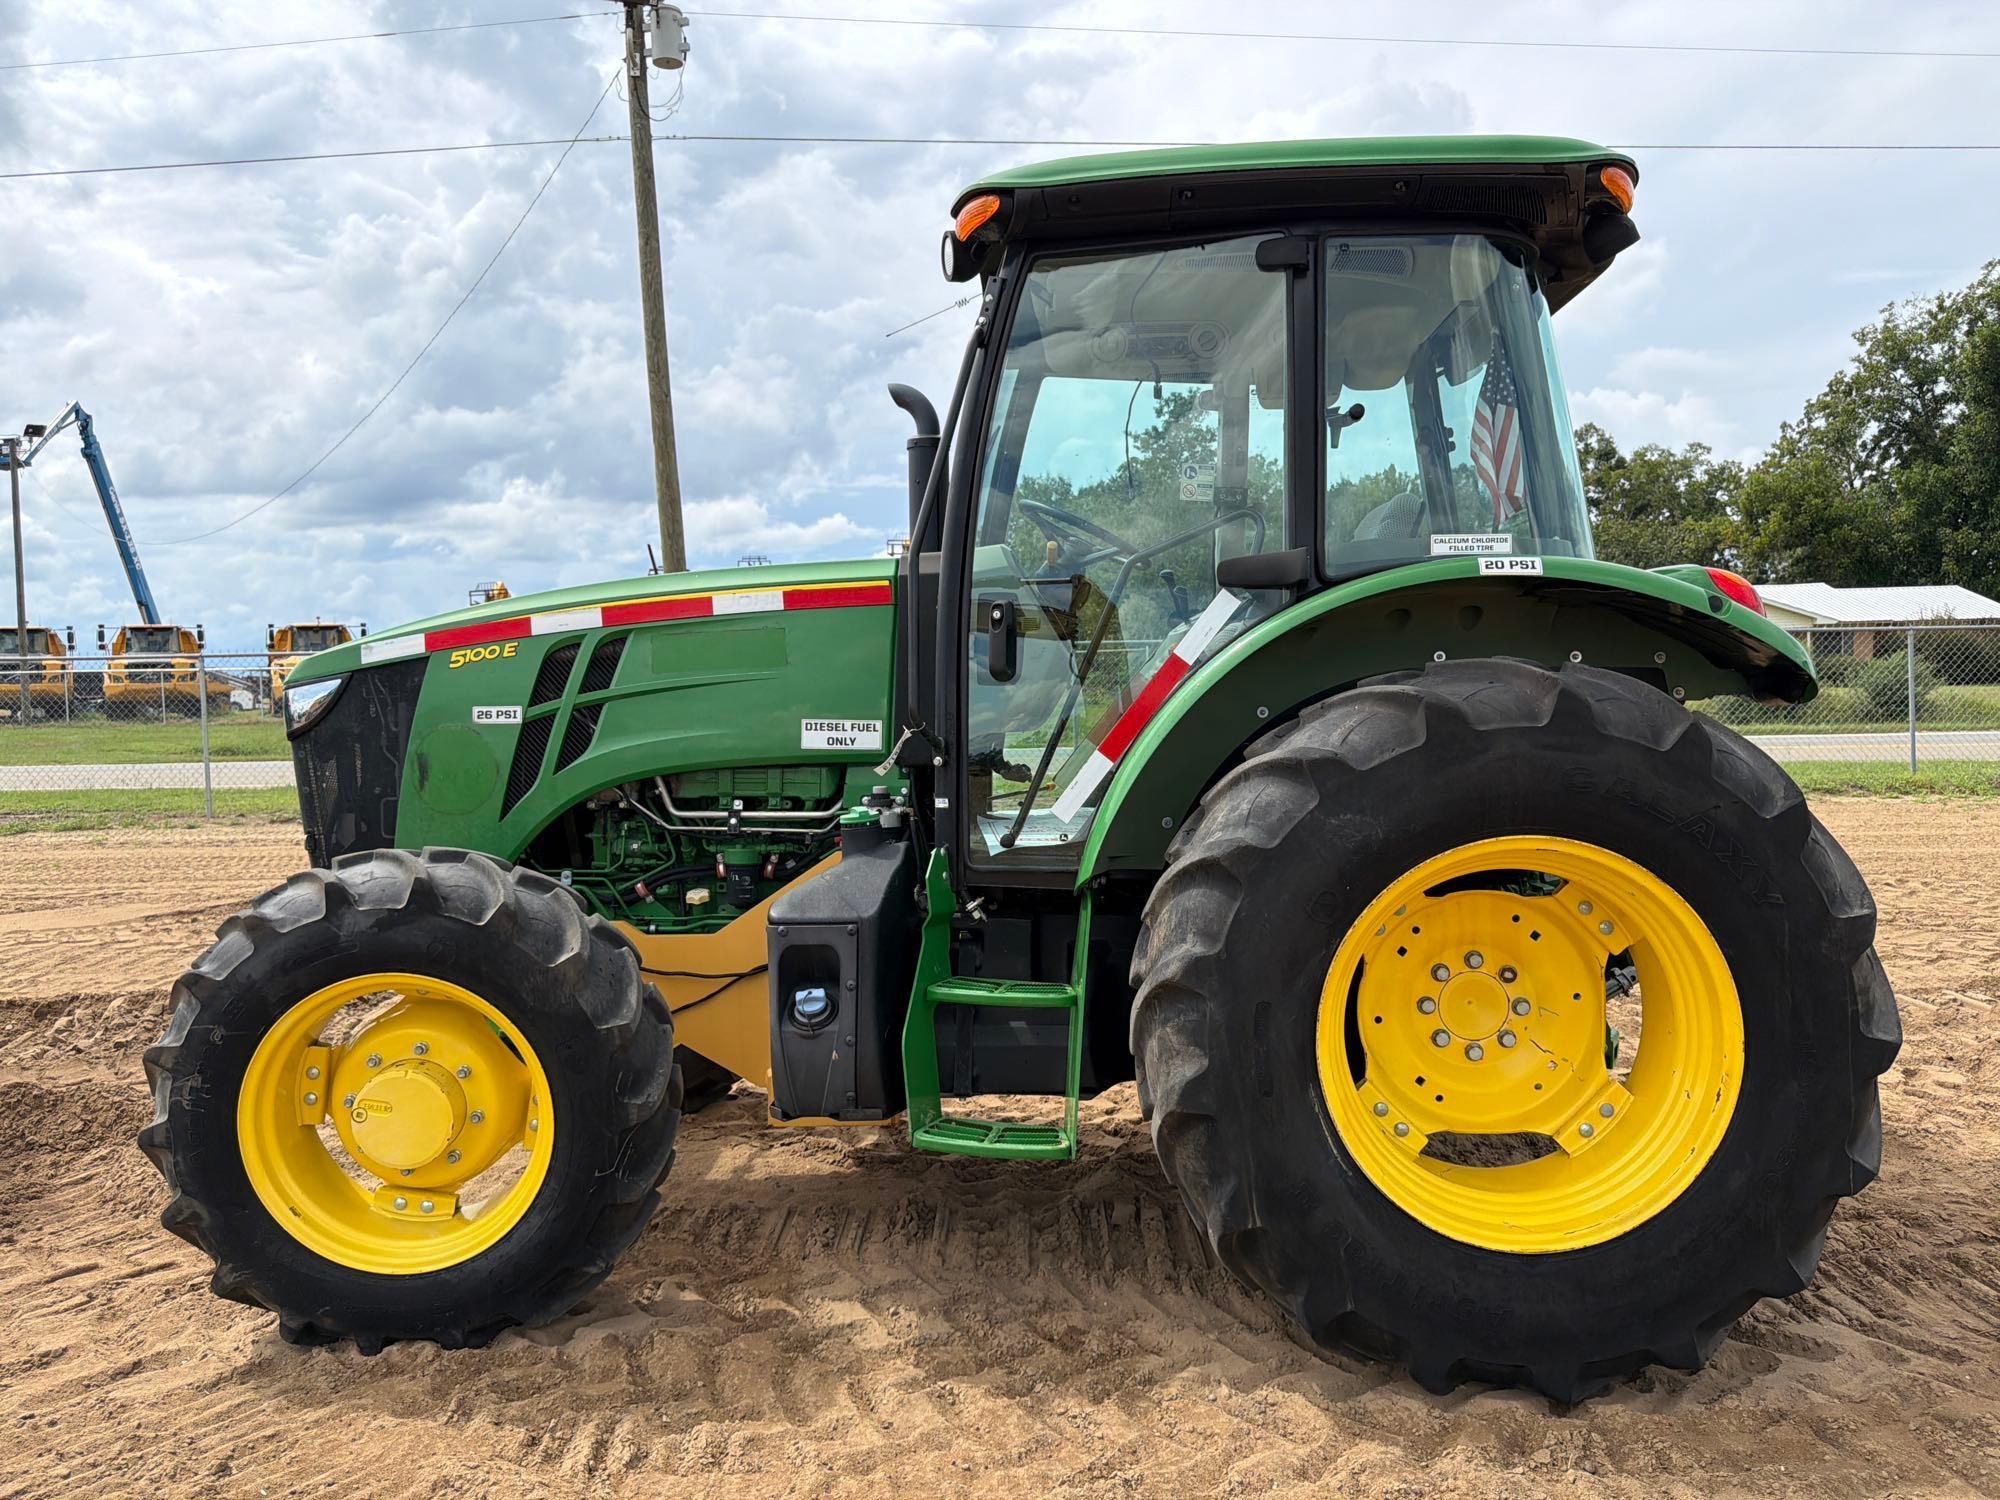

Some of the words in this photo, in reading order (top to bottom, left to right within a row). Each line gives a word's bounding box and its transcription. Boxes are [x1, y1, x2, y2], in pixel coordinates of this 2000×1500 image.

[109, 486, 121, 514] Genie
[1484, 560, 1505, 570] 20
[1509, 560, 1538, 570] PSI
[477, 710, 493, 720] 26
[496, 709, 518, 719] PSI
[805, 722, 847, 732] DIESEL
[851, 722, 879, 732] FUEL
[827, 737, 856, 746] ONLY
[1561, 766, 1785, 905] GALAXY
